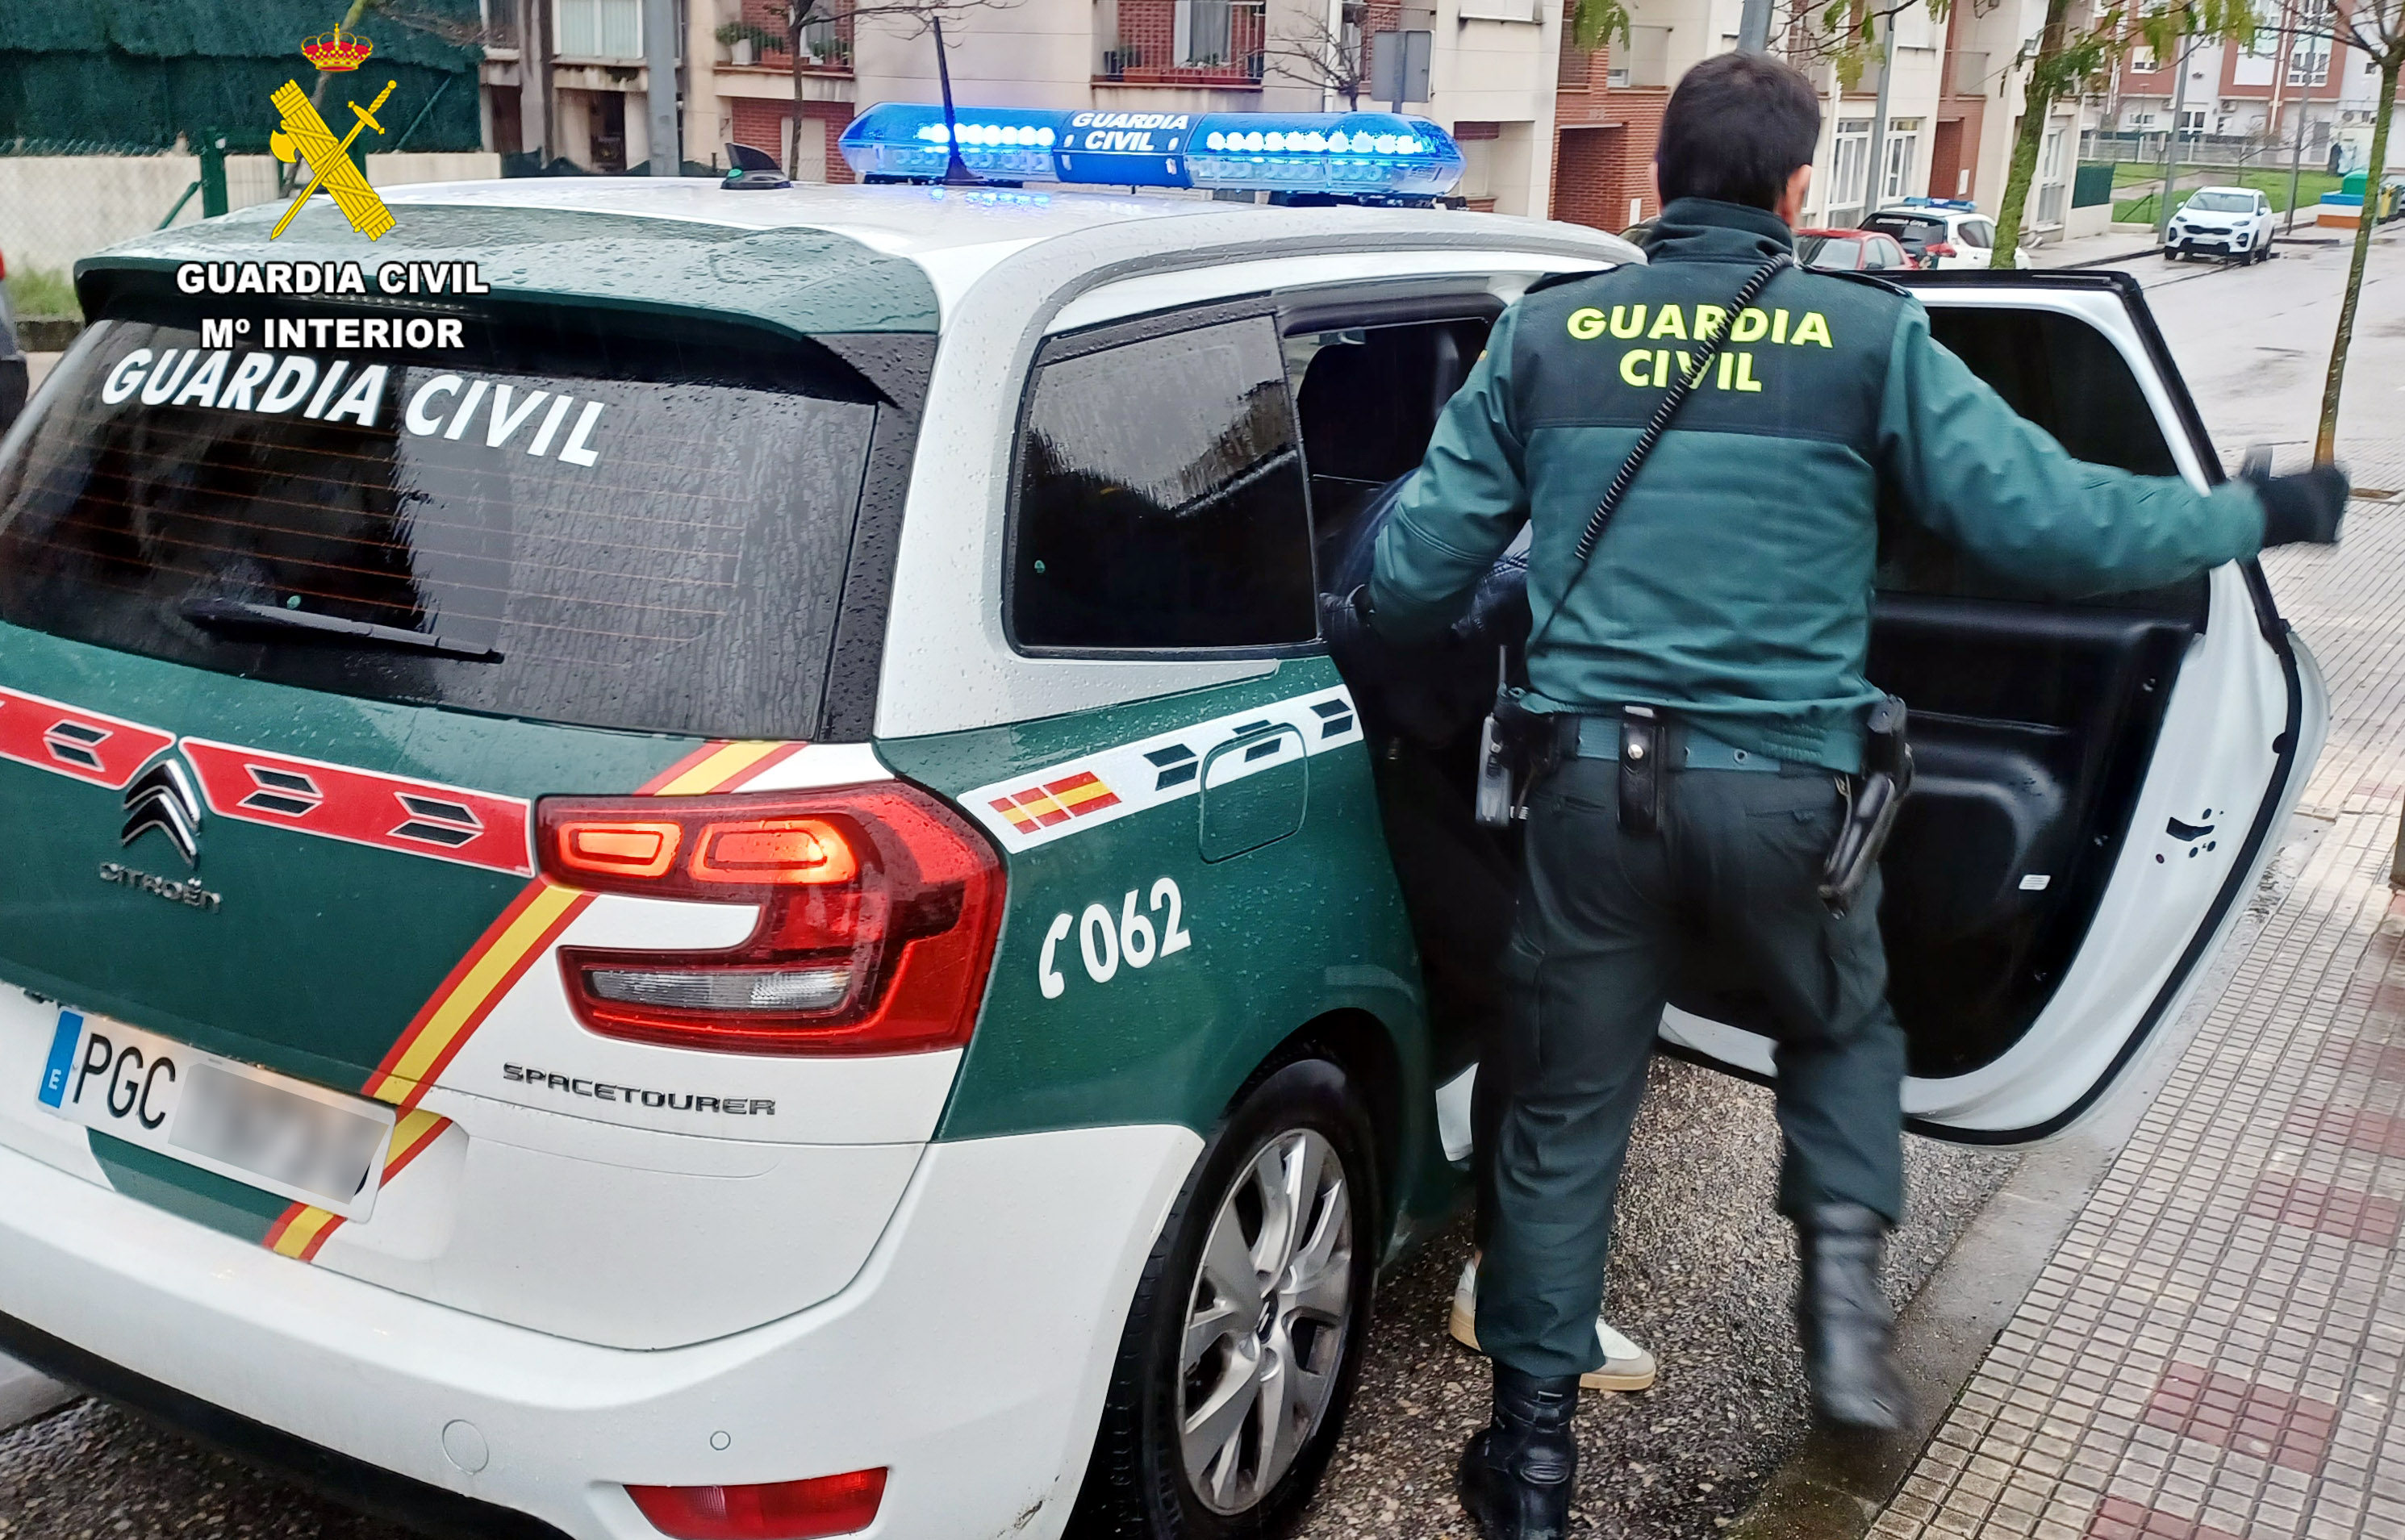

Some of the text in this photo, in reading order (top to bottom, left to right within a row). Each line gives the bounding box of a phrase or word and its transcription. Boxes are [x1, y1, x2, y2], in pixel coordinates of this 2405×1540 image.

[1071, 112, 1189, 130] GUARDIA
[1084, 130, 1154, 151] CIVIL
[1566, 303, 1834, 348] GUARDIA
[1618, 348, 1763, 393] CIVIL
[101, 348, 605, 468] GUARDIA CIVIL
[1079, 876, 1192, 984] 062
[48, 1032, 177, 1131] E PGC
[503, 1061, 776, 1116] SPACETOURER
